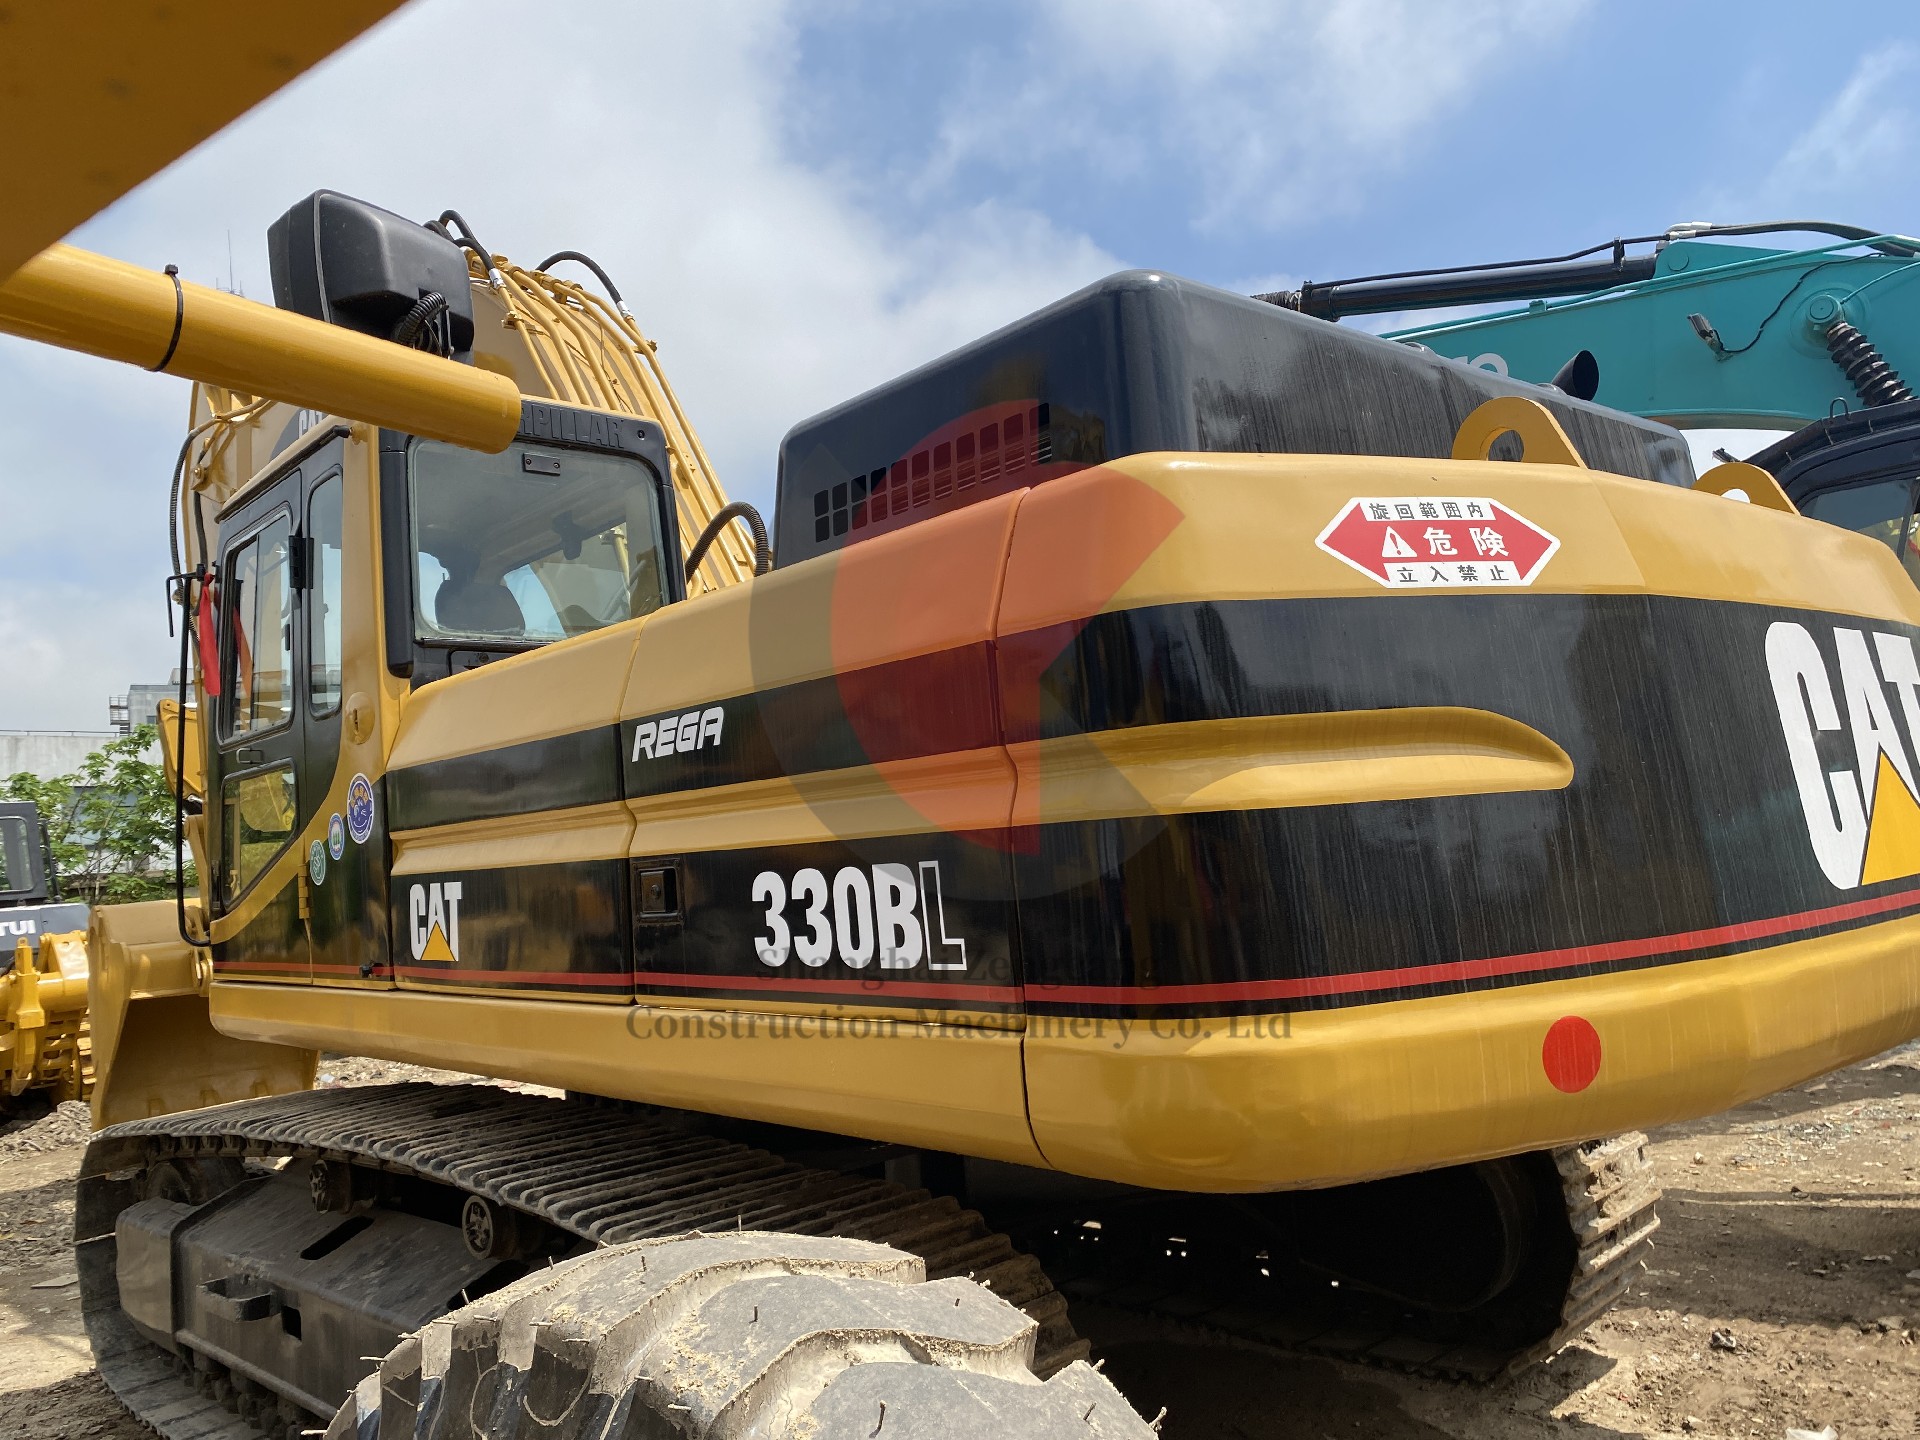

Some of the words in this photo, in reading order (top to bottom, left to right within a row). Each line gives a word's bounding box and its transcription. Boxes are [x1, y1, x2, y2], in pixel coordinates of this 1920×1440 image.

[1369, 502, 1483, 520] 旋回範囲内
[1423, 527, 1509, 557] 危険
[1397, 565, 1509, 582] 立入禁止
[632, 706, 724, 762] REGA
[409, 881, 462, 962] CAT
[752, 861, 967, 971] 330BL
